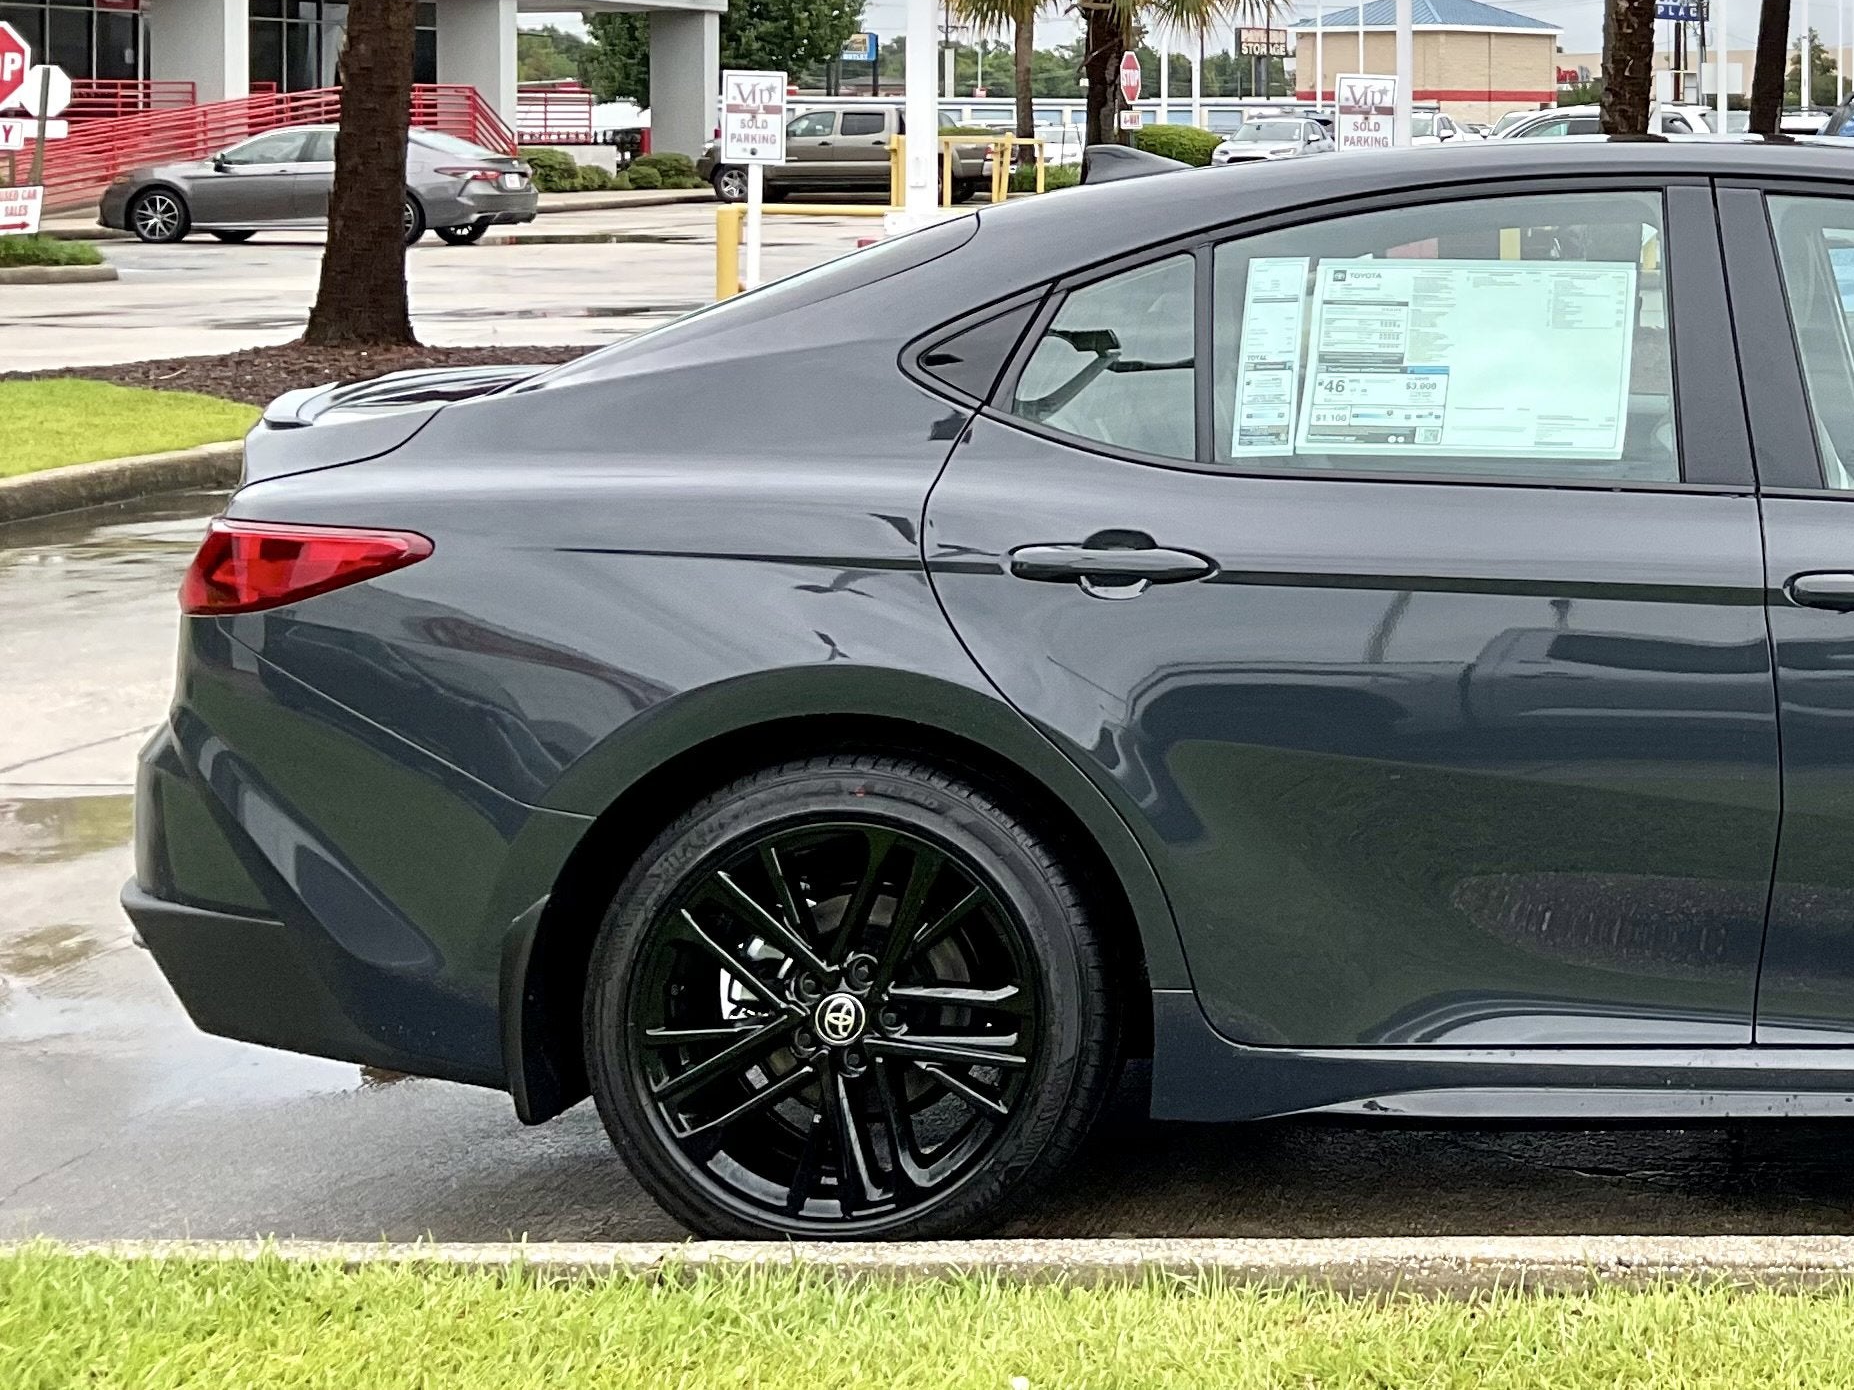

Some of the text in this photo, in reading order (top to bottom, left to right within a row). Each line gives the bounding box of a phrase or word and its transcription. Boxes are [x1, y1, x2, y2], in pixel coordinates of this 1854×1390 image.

[1121, 69, 1139, 87] STOP
[740, 118, 768, 130] SOLD
[1352, 121, 1381, 133] SOLD
[730, 132, 777, 145] PARKING
[1343, 135, 1389, 148] PARKING
[1323, 379, 1345, 393] 46
